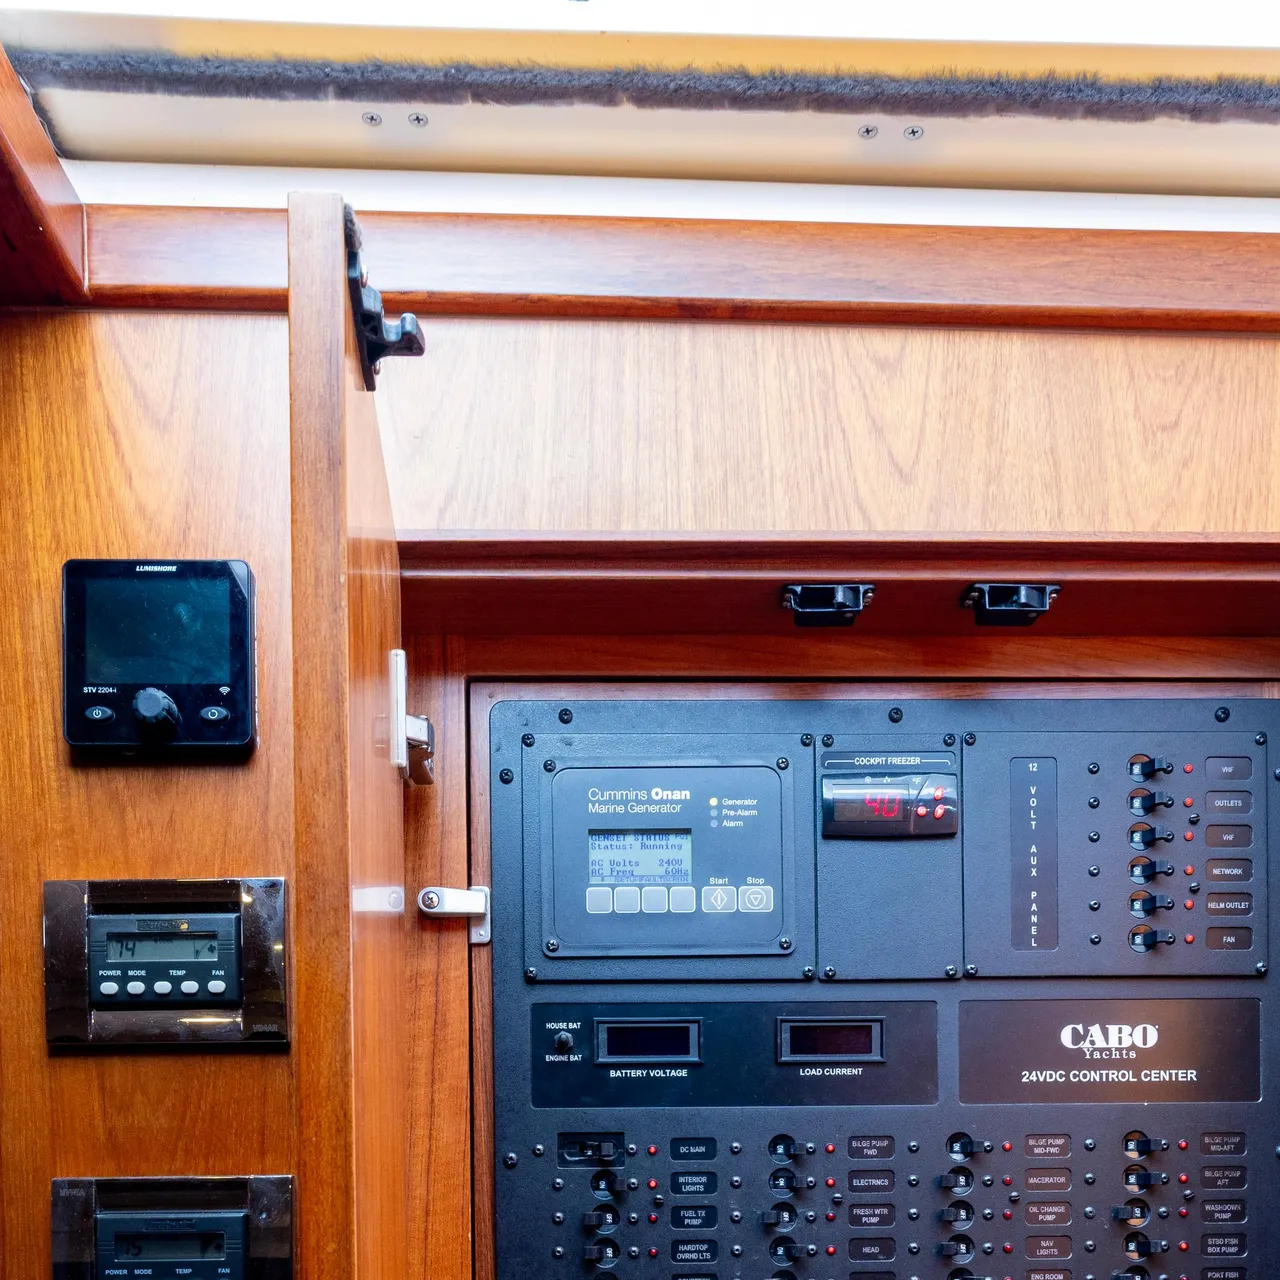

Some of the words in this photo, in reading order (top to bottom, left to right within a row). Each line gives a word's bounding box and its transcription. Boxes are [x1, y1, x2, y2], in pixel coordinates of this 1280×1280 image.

[83, 686, 97, 694] STV
[97, 686, 117, 694] 2204-i
[854, 757, 886, 765] COCKPIT
[888, 757, 920, 765] FREEZER
[1028, 763, 1038, 771] 12
[588, 787, 648, 801] Cummins
[650, 788, 691, 801] Onan
[722, 798, 758, 806] Generator
[588, 803, 625, 813] Marine
[627, 803, 682, 813] Generator
[591, 834, 626, 842] GENSET
[634, 834, 670, 842] STATUS
[591, 842, 633, 850] Status:
[640, 842, 682, 851] Running
[609, 859, 640, 867] Volts
[1030, 845, 1038, 877] AUX
[610, 868, 634, 876] Freq
[1134, 867, 1141, 876] ON
[709, 877, 728, 885] Start
[746, 877, 765, 886] Stop
[1060, 1023, 1159, 1049] CABO
[1083, 1048, 1137, 1059] Yachts
[610, 1069, 647, 1078] BATTERY
[648, 1069, 688, 1078] VOLTAGE
[800, 1068, 822, 1076] LOAD
[824, 1068, 863, 1076] CURRENT
[1021, 1070, 1066, 1082] 24VDC
[1069, 1070, 1137, 1082] CONTROL
[1141, 1069, 1198, 1082] CENTER
